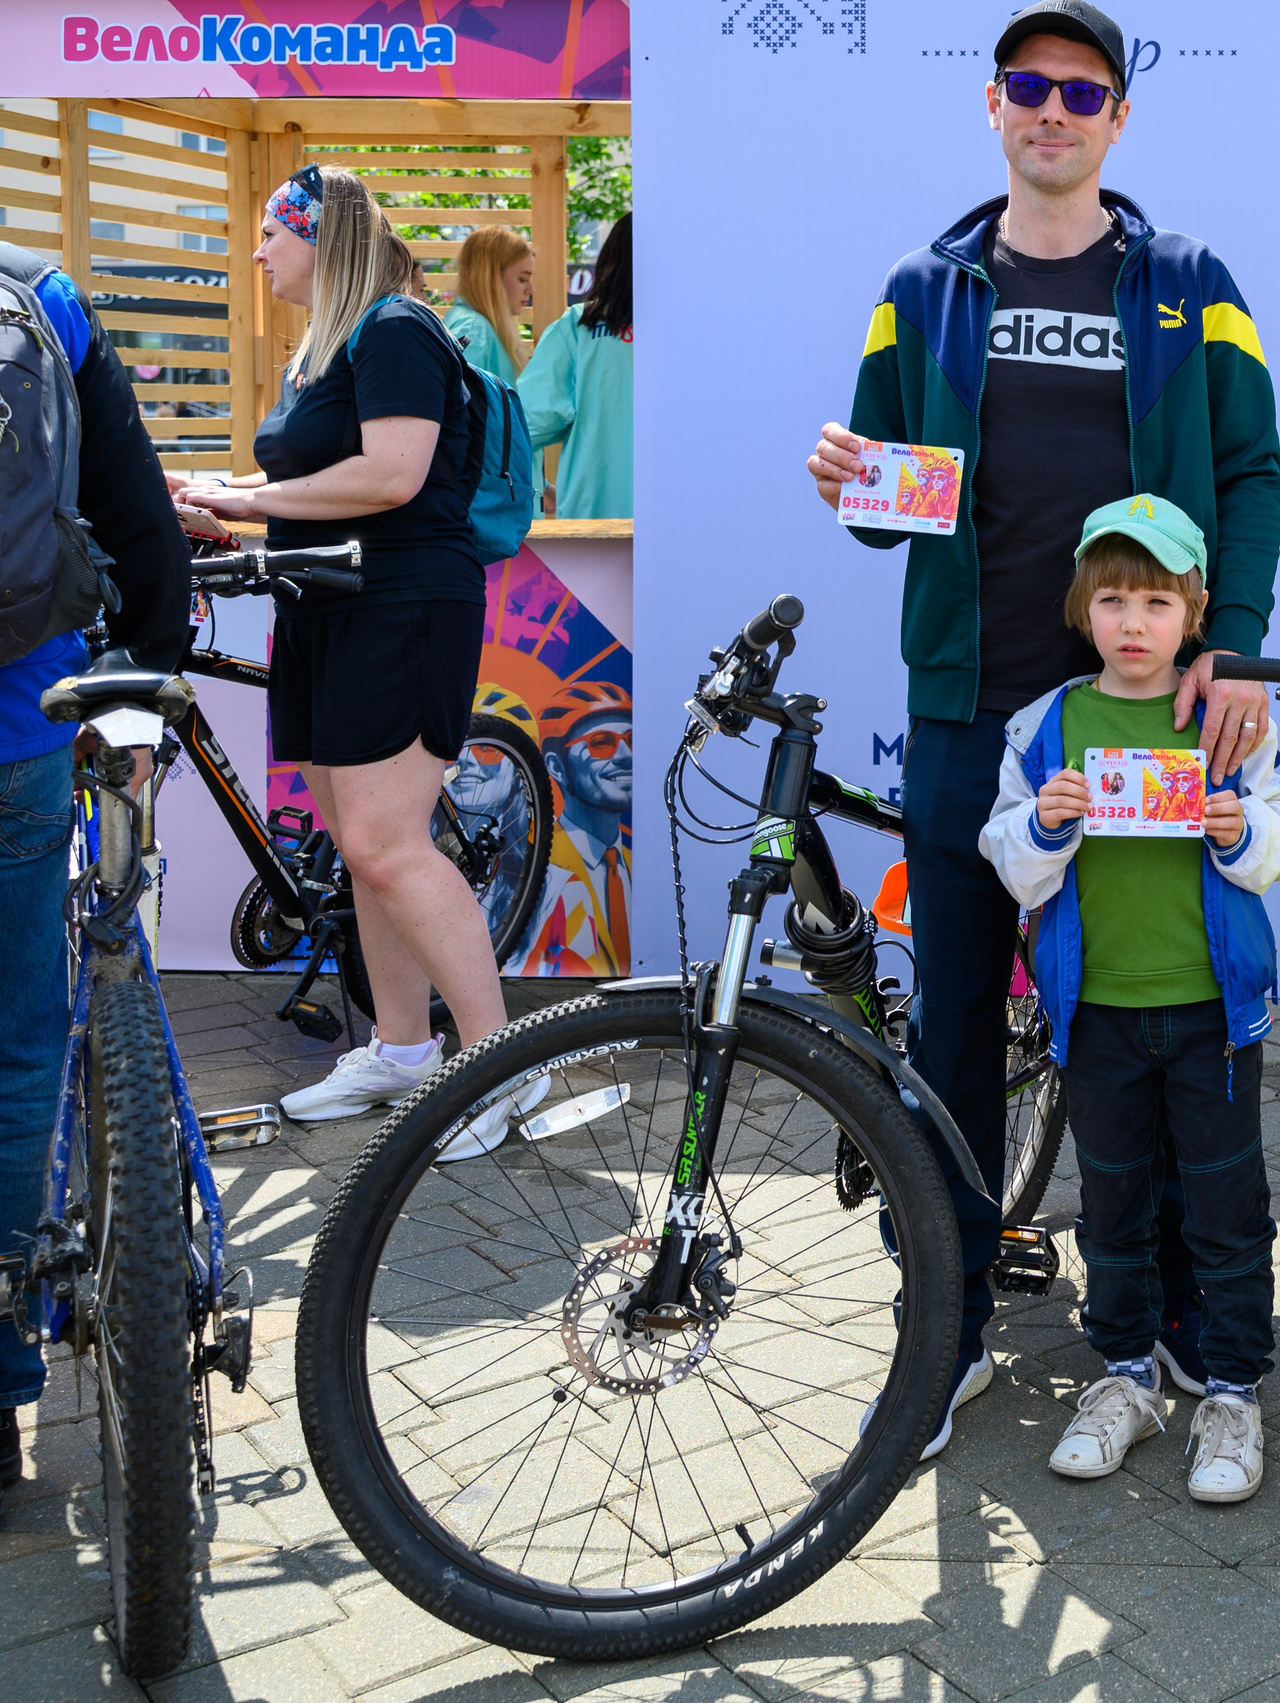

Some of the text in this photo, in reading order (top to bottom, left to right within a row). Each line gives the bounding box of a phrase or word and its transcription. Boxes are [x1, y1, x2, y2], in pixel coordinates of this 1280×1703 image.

[62, 16, 454, 70] ВелоКоманда
[1159, 318, 1182, 329] PUMA
[842, 496, 890, 512] 05329
[237, 664, 269, 680] NAVI
[1087, 806, 1136, 819] 05328
[524, 1038, 641, 1083] ALEXRIMS
[677, 1157, 693, 1186] SR
[722, 1519, 825, 1599] KENDA
